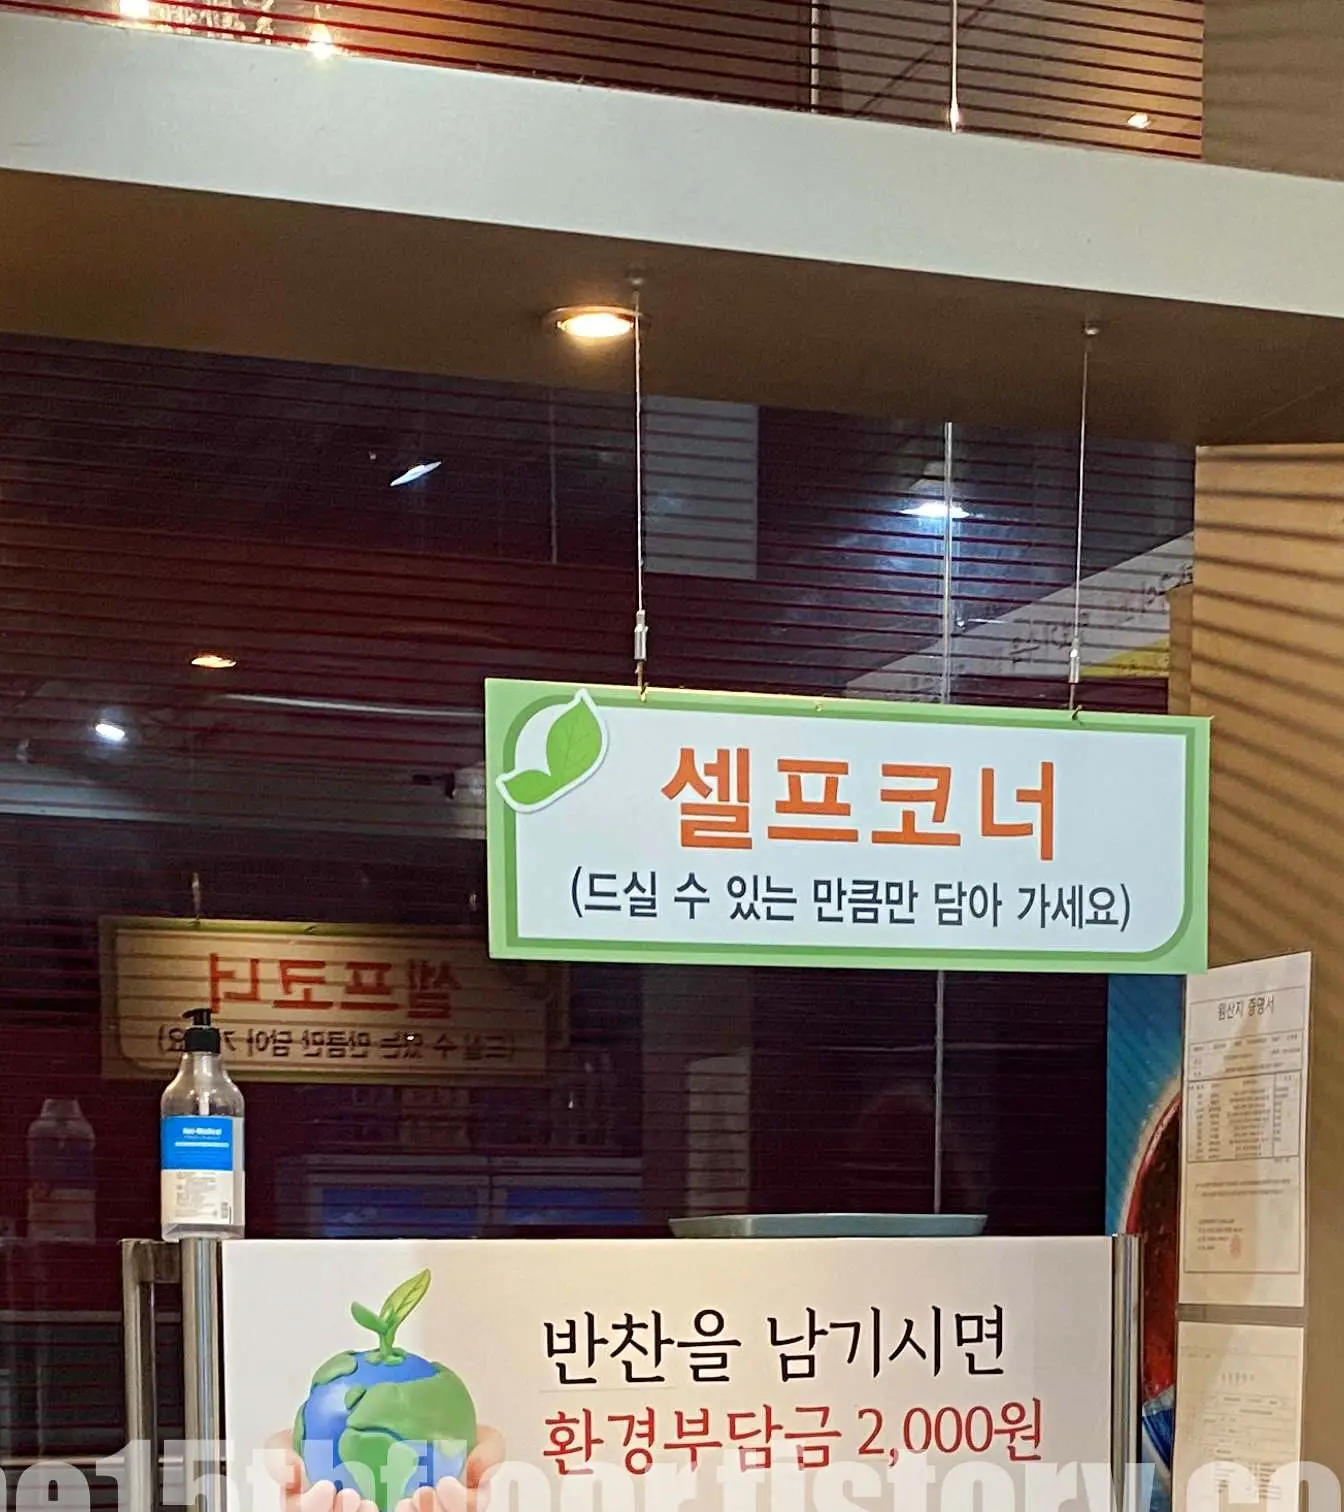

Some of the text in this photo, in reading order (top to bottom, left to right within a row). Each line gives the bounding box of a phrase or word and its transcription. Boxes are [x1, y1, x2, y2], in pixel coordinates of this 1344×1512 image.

[660, 746, 1056, 861] 셀프코너
[571, 864, 1131, 932] (드실 수 있는 만큼만 담아 가세요)
[543, 1303, 1008, 1386] 반찬을 남기시면
[543, 1397, 1045, 1478] 환경부담금 2,000원
